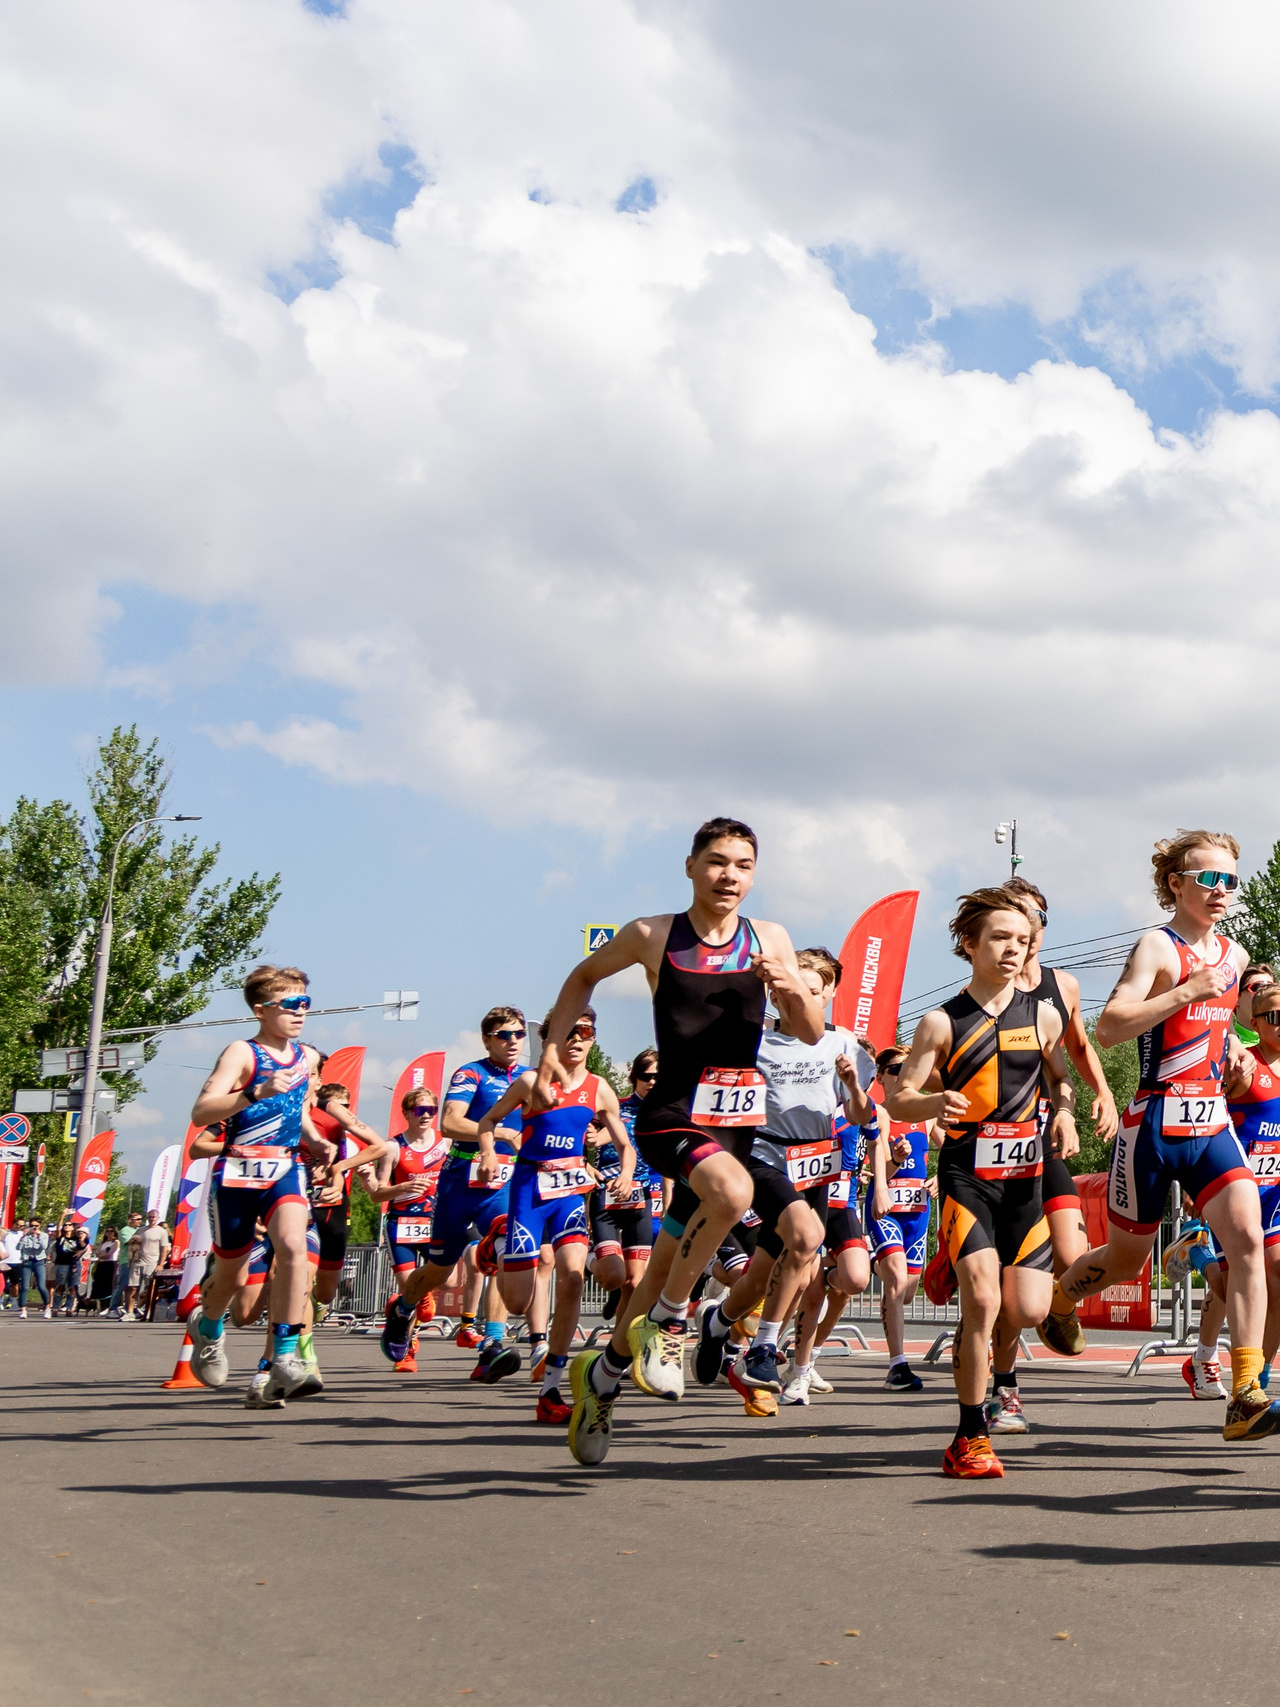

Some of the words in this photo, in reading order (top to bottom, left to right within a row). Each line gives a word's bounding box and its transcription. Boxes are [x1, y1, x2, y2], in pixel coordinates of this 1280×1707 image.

[860, 936, 882, 995] МОСКВЫ
[854, 998, 873, 1040] НСТВО
[1186, 1003, 1233, 1025] Lukyanov
[710, 1089, 756, 1112] 118
[1179, 1100, 1215, 1123] 127
[544, 1134, 575, 1150] RUS
[992, 1140, 1037, 1164] 140
[238, 1161, 279, 1179] 117
[797, 1155, 832, 1179] 105
[900, 1158, 915, 1170] US
[1115, 1136, 1129, 1209] AQUATICS
[550, 1171, 586, 1189] 116
[894, 1190, 922, 1203] 138
[405, 1225, 430, 1237] 134
[1101, 1281, 1142, 1302] МОСКОВСКИЙ
[1110, 1305, 1130, 1323] СПОРТ
